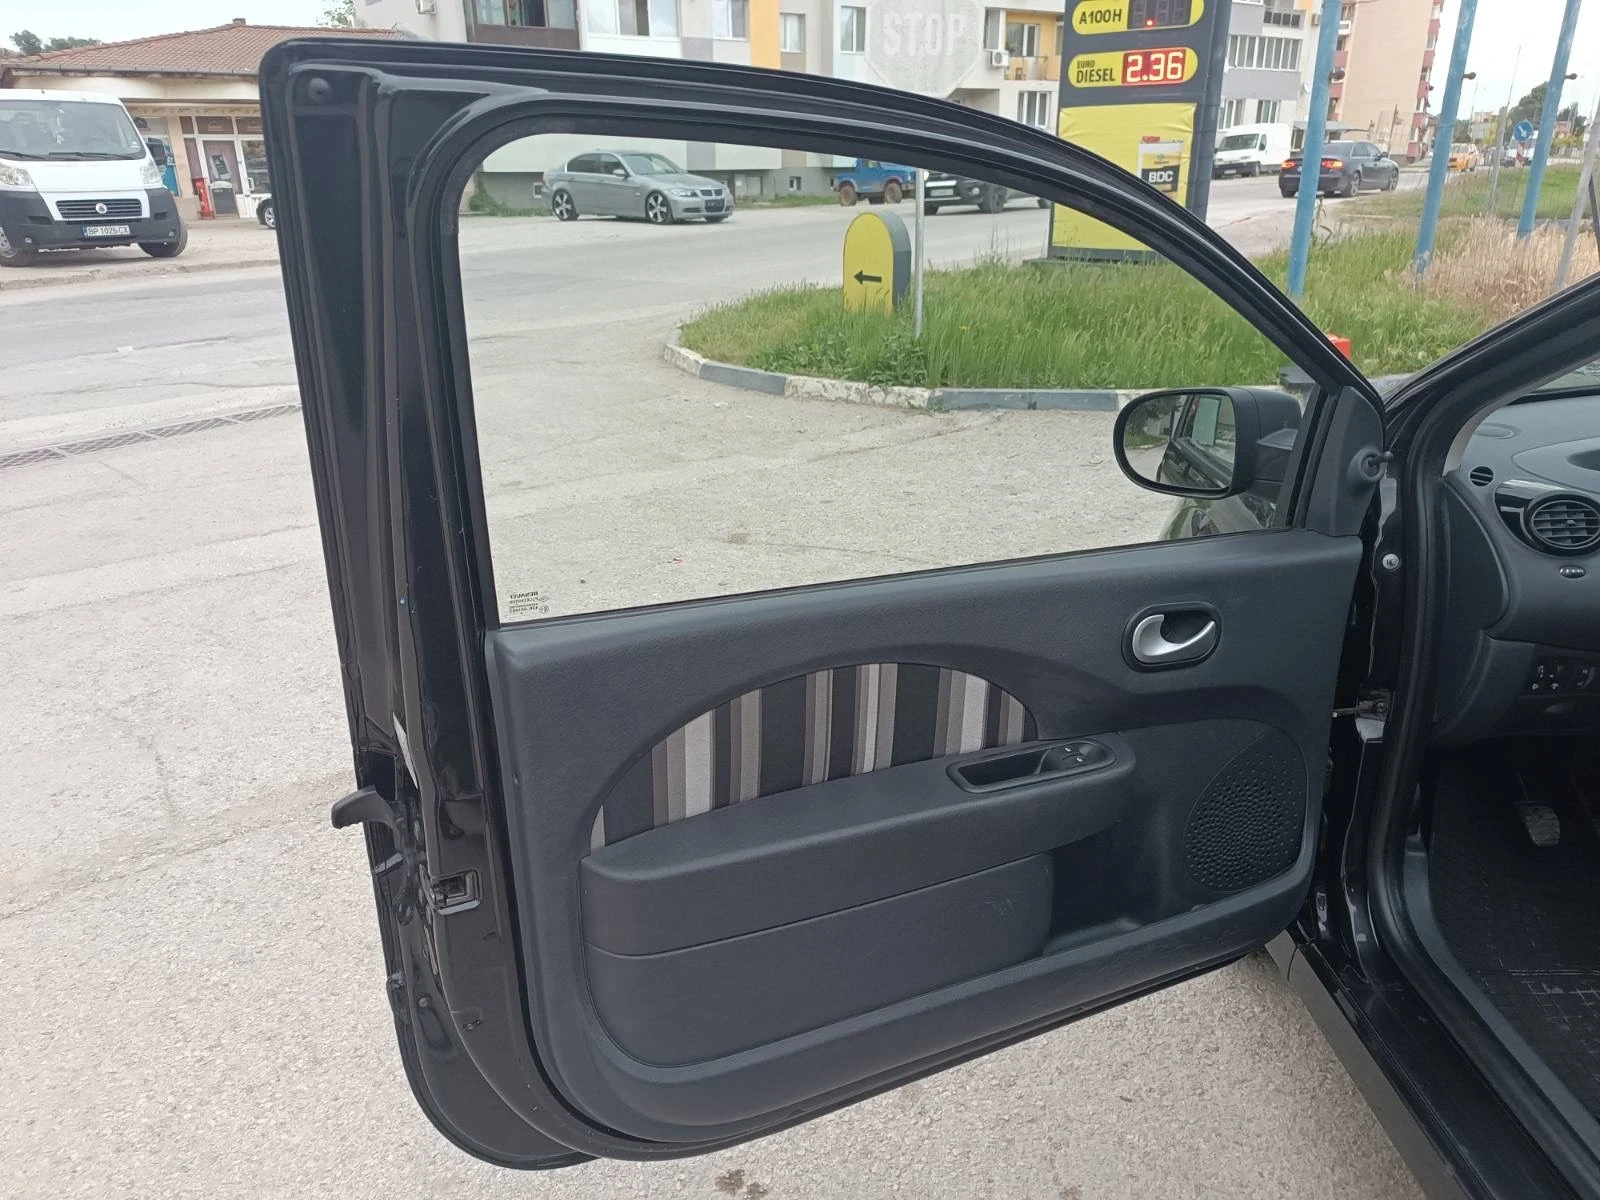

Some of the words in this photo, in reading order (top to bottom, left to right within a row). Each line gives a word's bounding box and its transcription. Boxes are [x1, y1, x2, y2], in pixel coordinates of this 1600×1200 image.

[882, 12, 965, 56] STOP
[1076, 68, 1115, 83] DIESEL
[1077, 60, 1095, 69] EURO
[1126, 51, 1184, 83] 2.36
